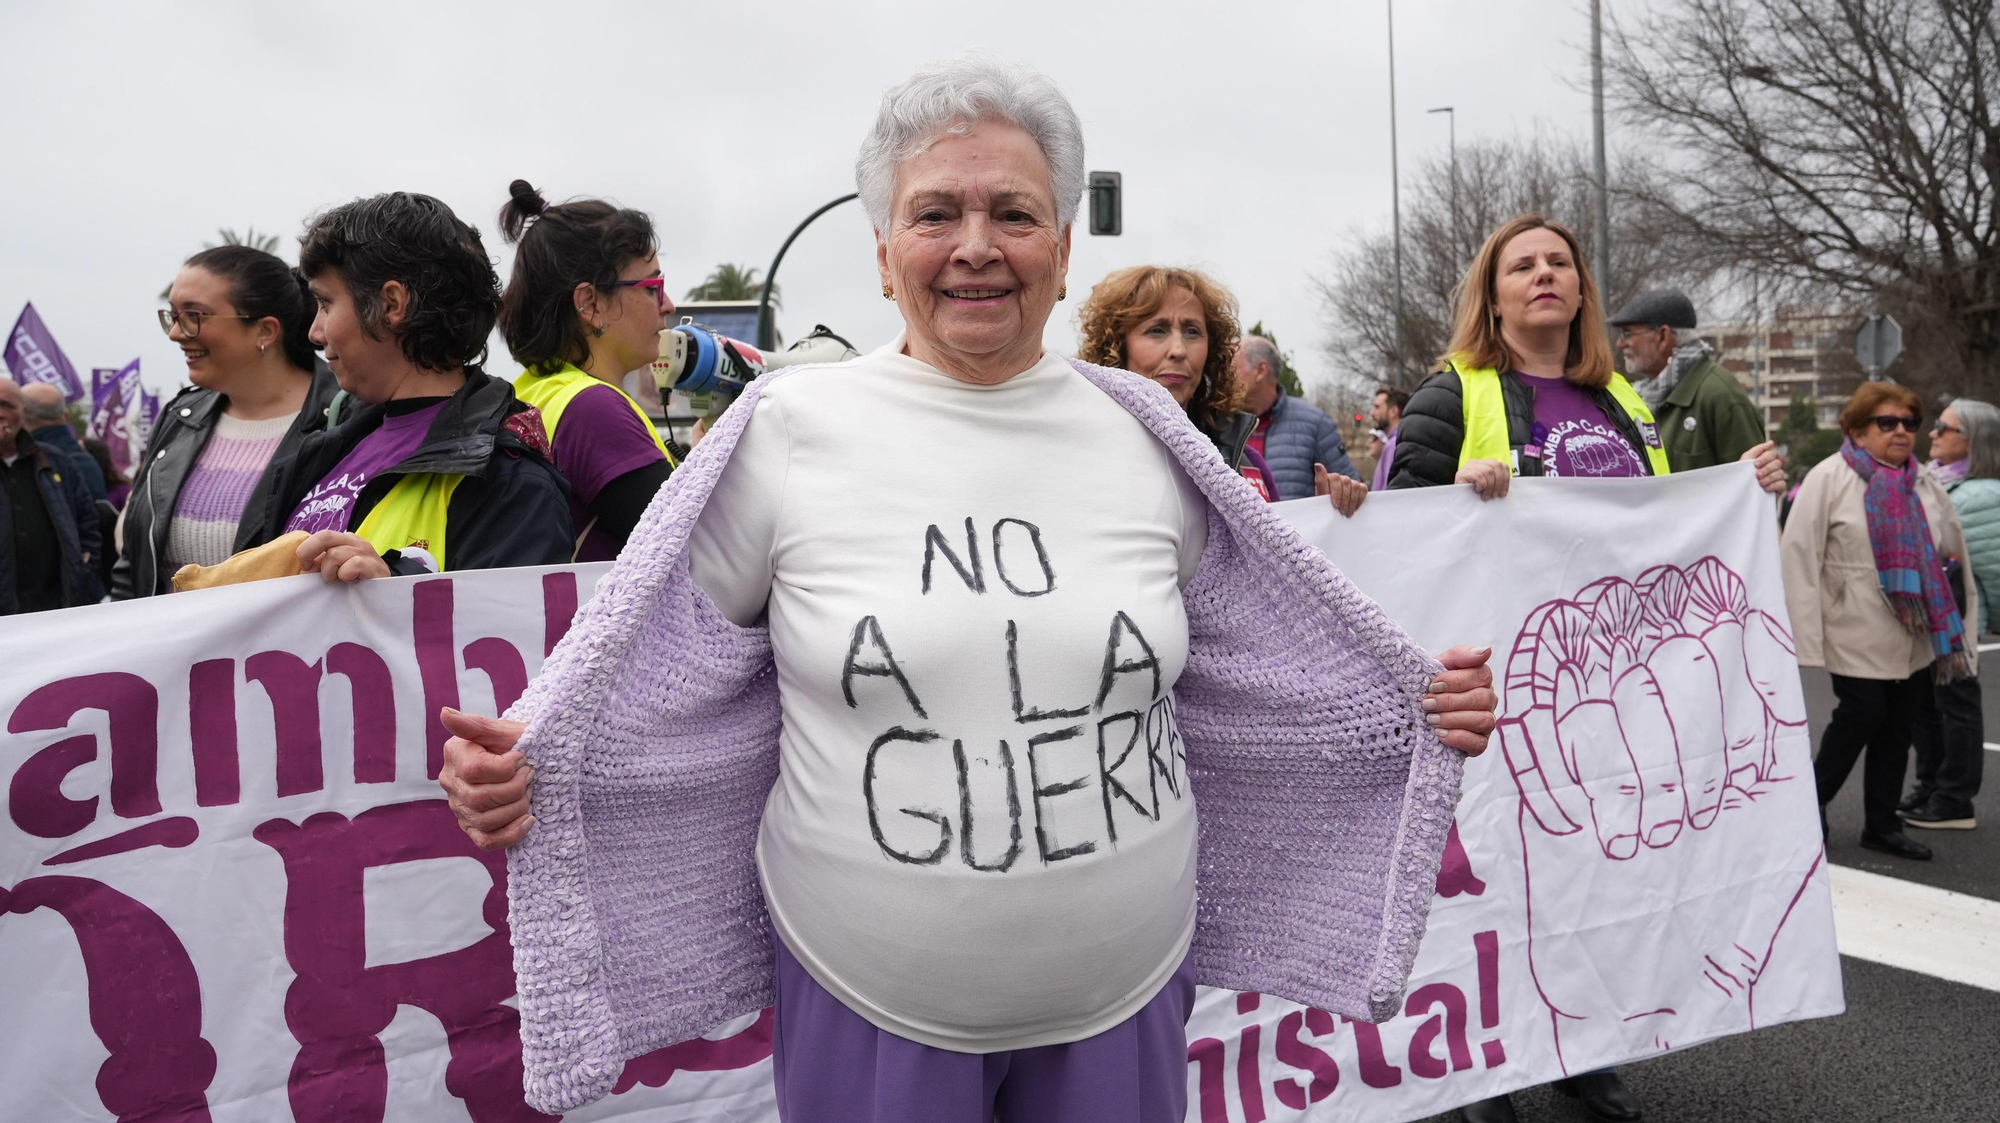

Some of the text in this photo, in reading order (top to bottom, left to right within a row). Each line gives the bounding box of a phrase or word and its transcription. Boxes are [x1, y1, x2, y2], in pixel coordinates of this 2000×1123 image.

[922, 516, 1058, 598] NO
[841, 610, 1163, 724] A LA
